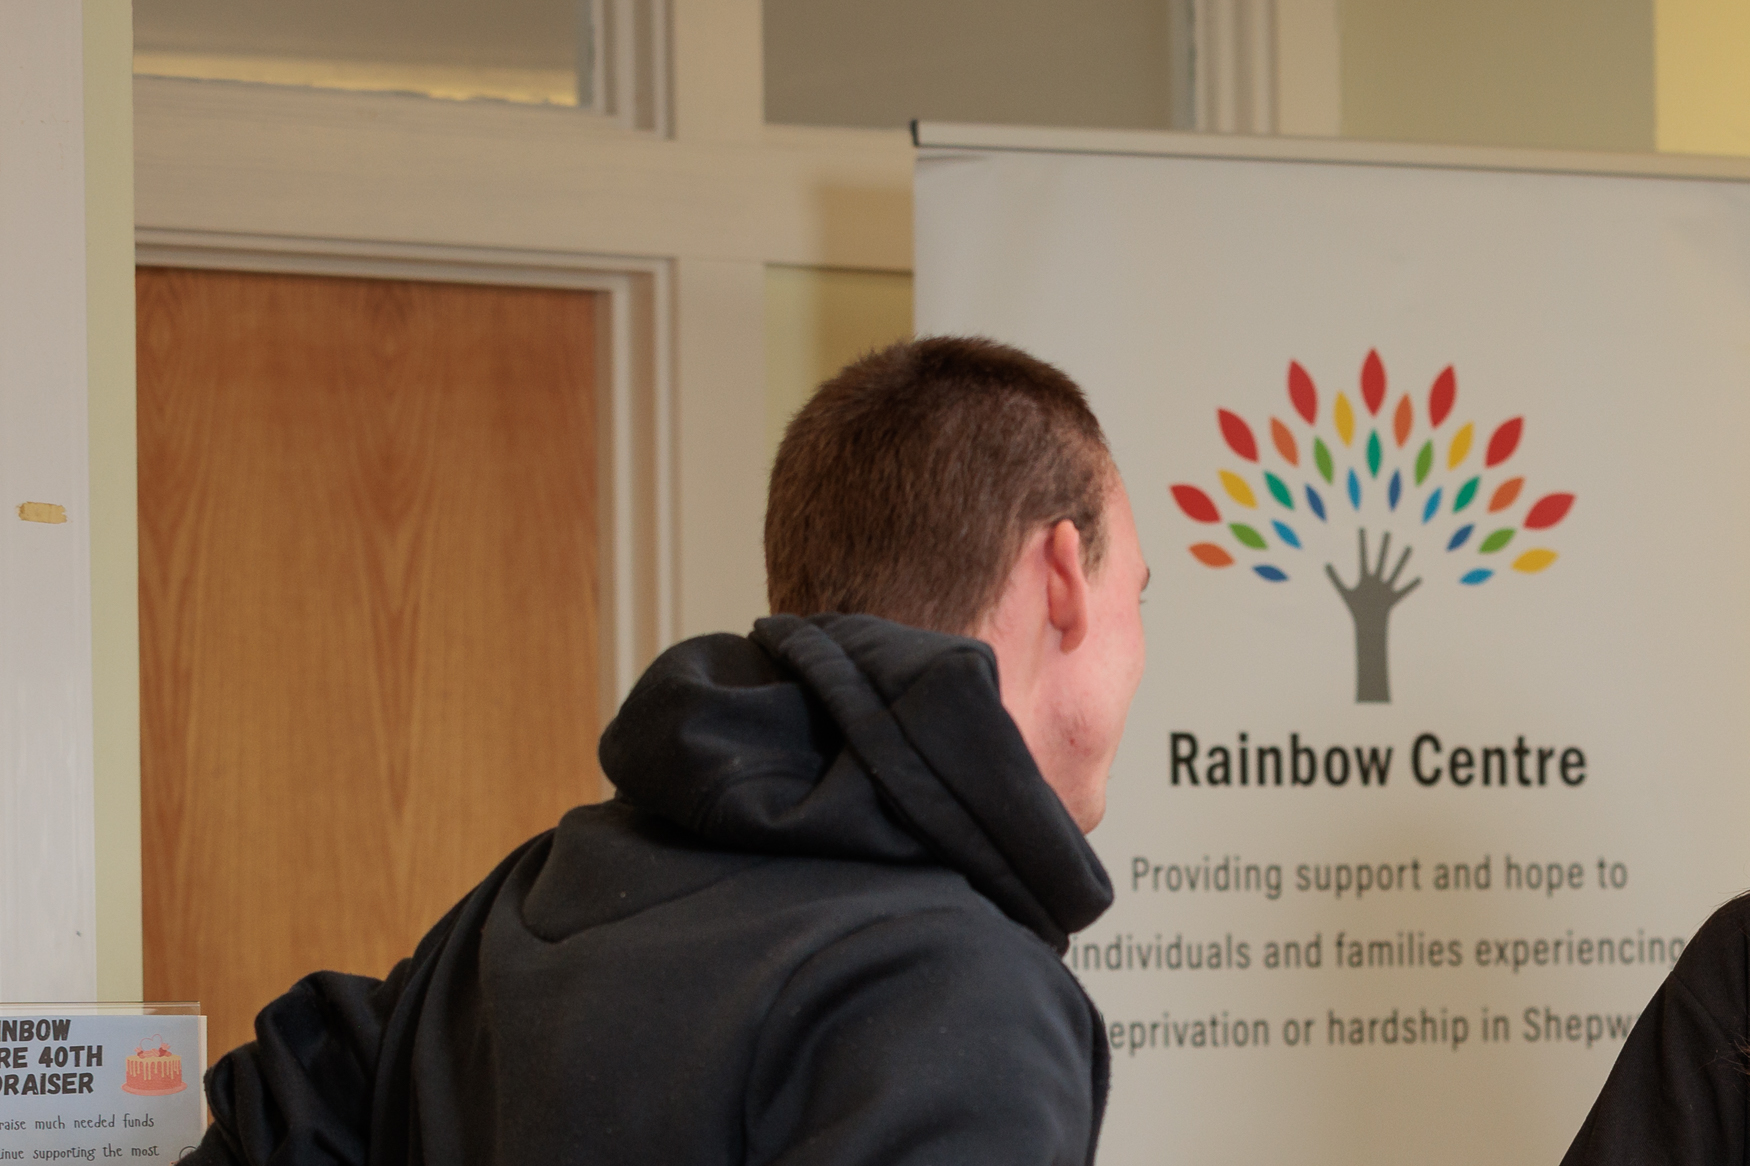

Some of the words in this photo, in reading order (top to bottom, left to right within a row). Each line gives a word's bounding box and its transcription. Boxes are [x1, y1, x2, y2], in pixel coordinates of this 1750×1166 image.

[1169, 732, 1394, 788] Rainbow
[1411, 733, 1588, 788] Centre
[1132, 856, 1283, 900] Providing
[1296, 857, 1422, 898] support
[1433, 854, 1492, 891] and
[1505, 854, 1585, 898] hope
[1597, 856, 1628, 890] to
[1071, 932, 1251, 971] individuals
[1264, 932, 1323, 969] and
[1336, 930, 1463, 969] families
[1475, 928, 1686, 975] experiencing
[1108, 1010, 1271, 1058] eprivation
[1283, 1018, 1315, 1046] or
[1328, 1007, 1470, 1051] hardship
[1481, 1006, 1511, 1043] in
[1522, 1005, 1638, 1049] Shepw
[38, 1044, 103, 1068] 40TH
[0, 1072, 95, 1096] RAISER
[0, 1118, 27, 1131] raise
[35, 1114, 66, 1130] much
[74, 1113, 115, 1129] needed
[123, 1112, 155, 1128] funds
[33, 1146, 97, 1162] supporting
[102, 1143, 123, 1158] the
[131, 1145, 160, 1157] most
